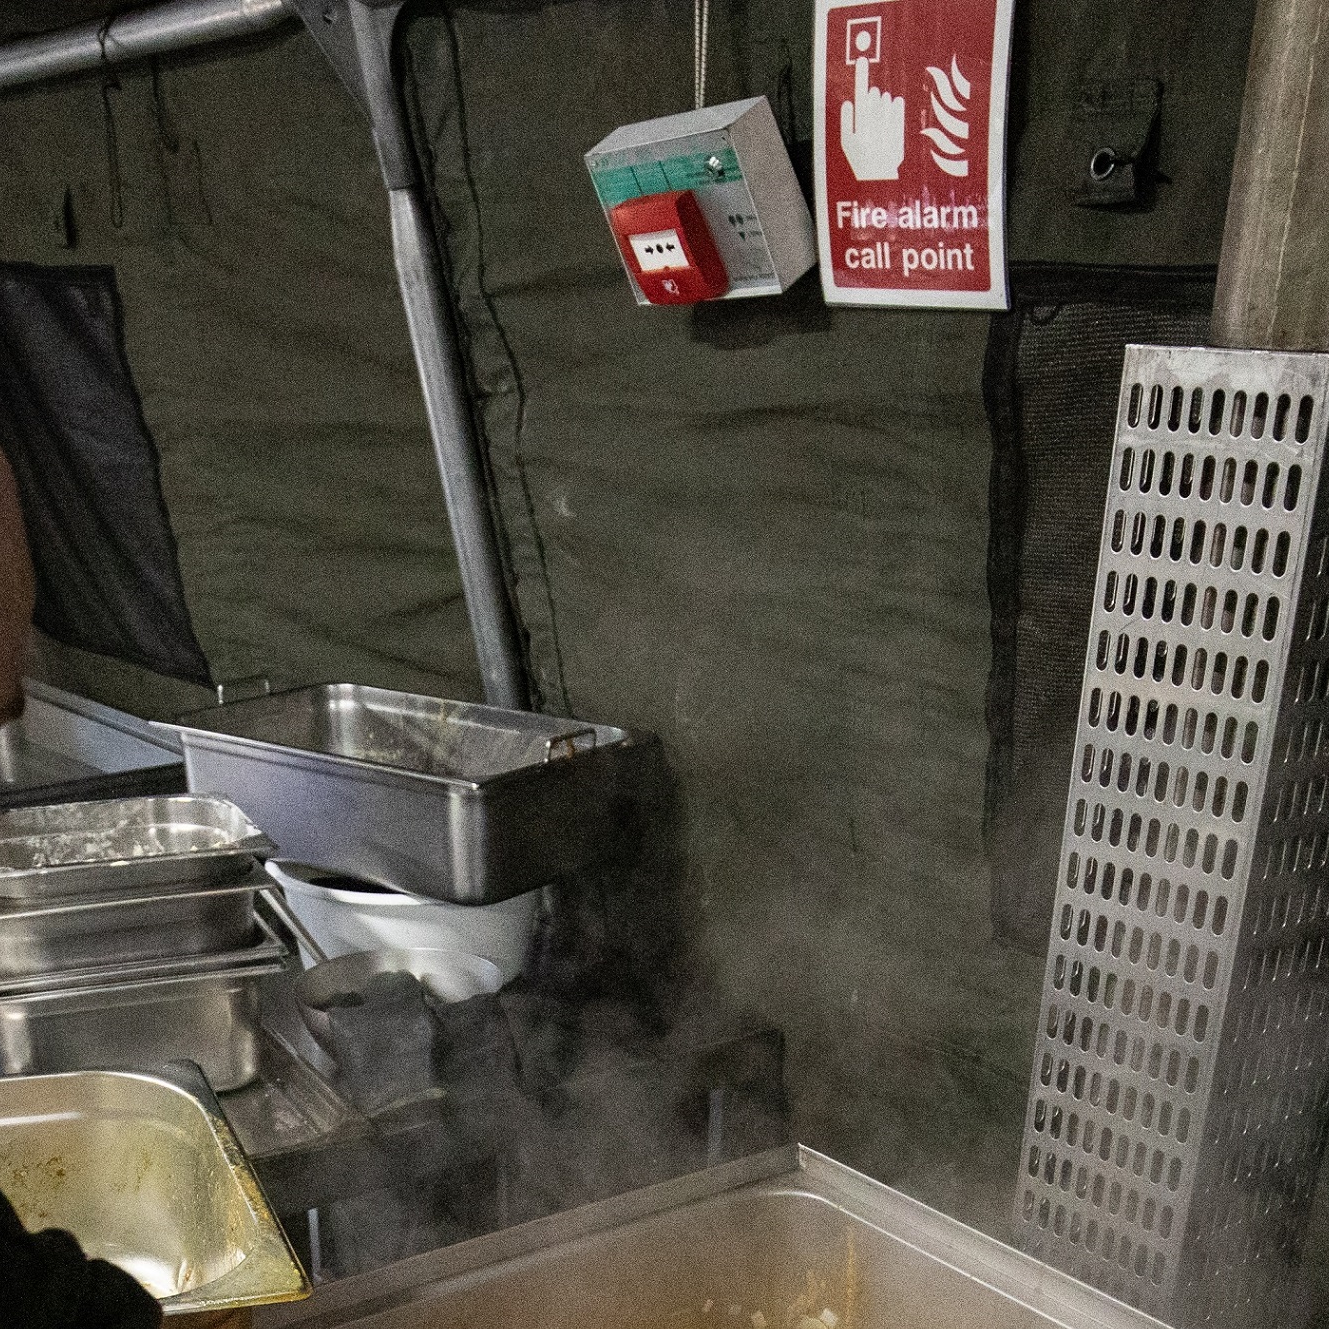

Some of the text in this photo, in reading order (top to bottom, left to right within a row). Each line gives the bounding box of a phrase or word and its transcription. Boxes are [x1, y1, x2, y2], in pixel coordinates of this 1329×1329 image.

[836, 200, 978, 230] Fire alarm
[844, 241, 974, 277] call point
